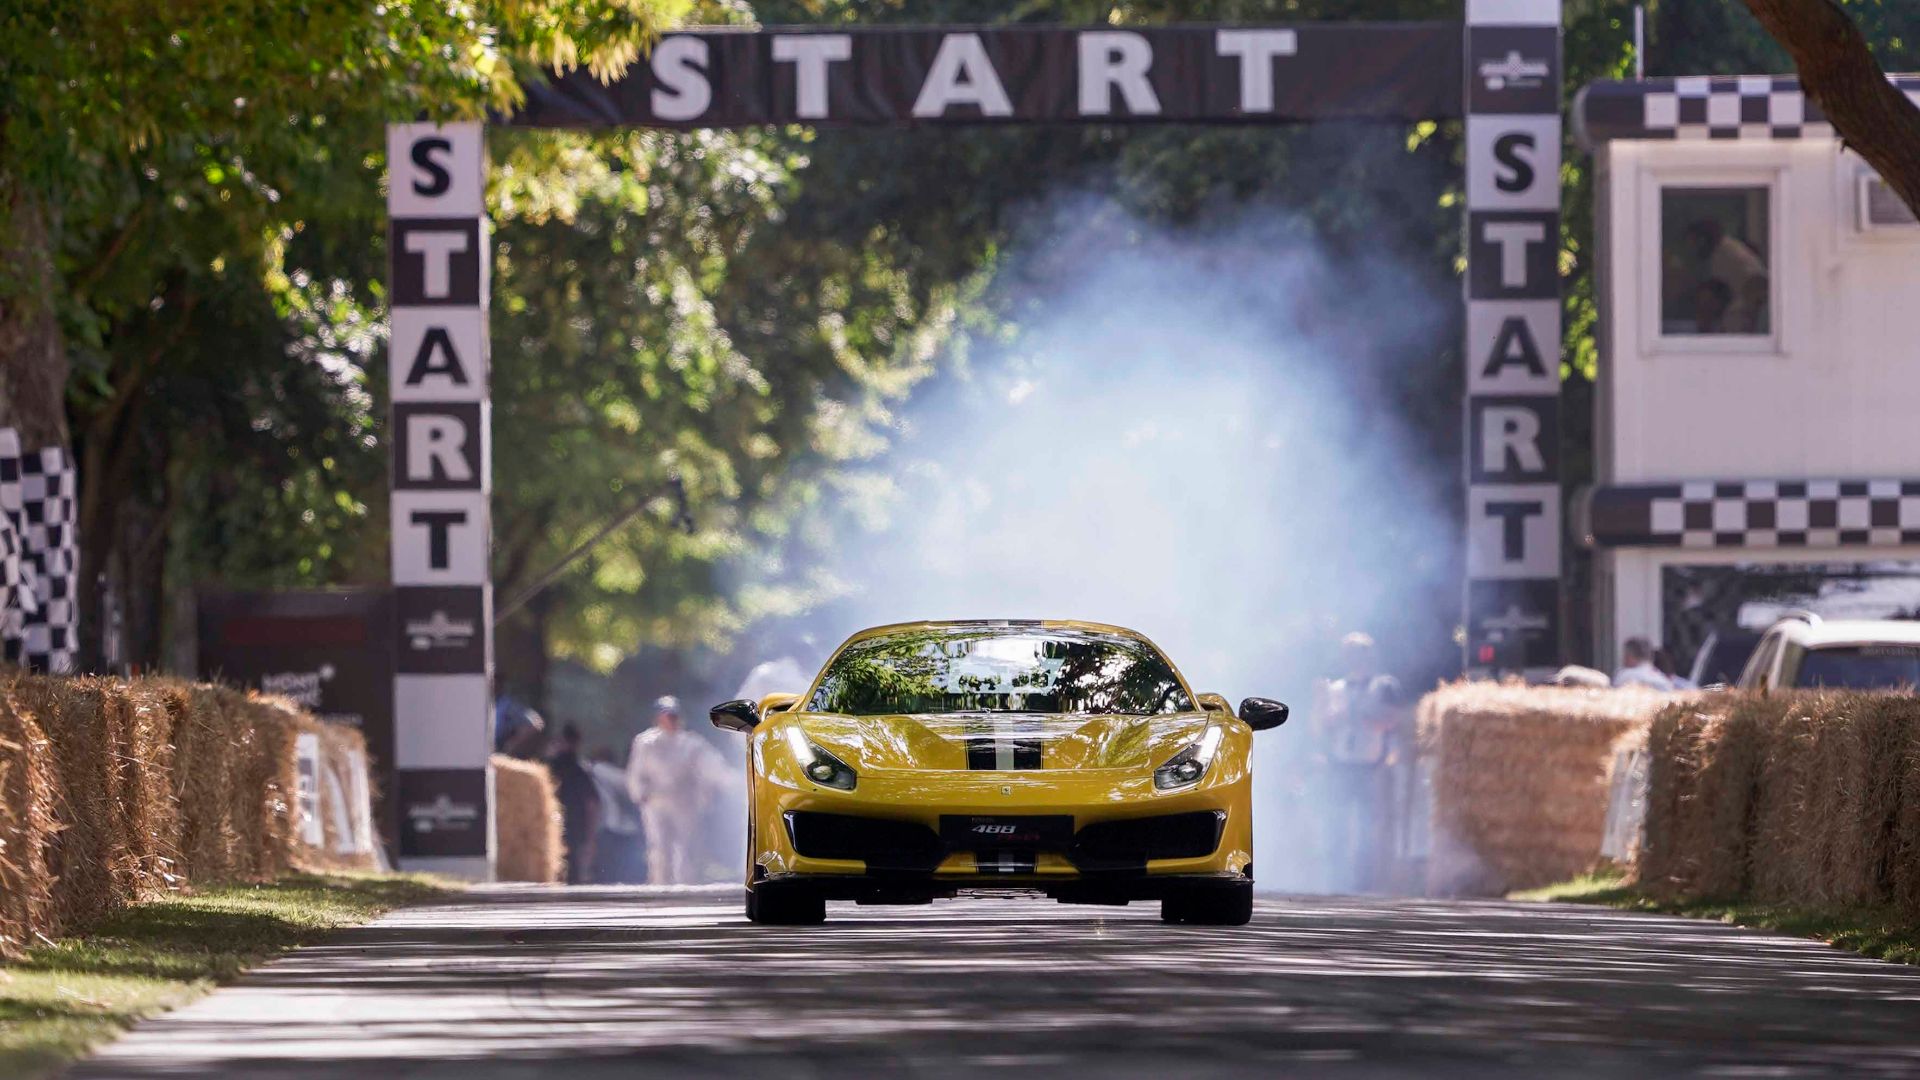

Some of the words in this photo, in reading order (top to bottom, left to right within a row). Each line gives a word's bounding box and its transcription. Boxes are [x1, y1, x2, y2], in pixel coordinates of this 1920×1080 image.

[651, 29, 1297, 121] START
[404, 137, 472, 569] START
[1482, 132, 1547, 561] START
[971, 824, 1016, 834] 488
